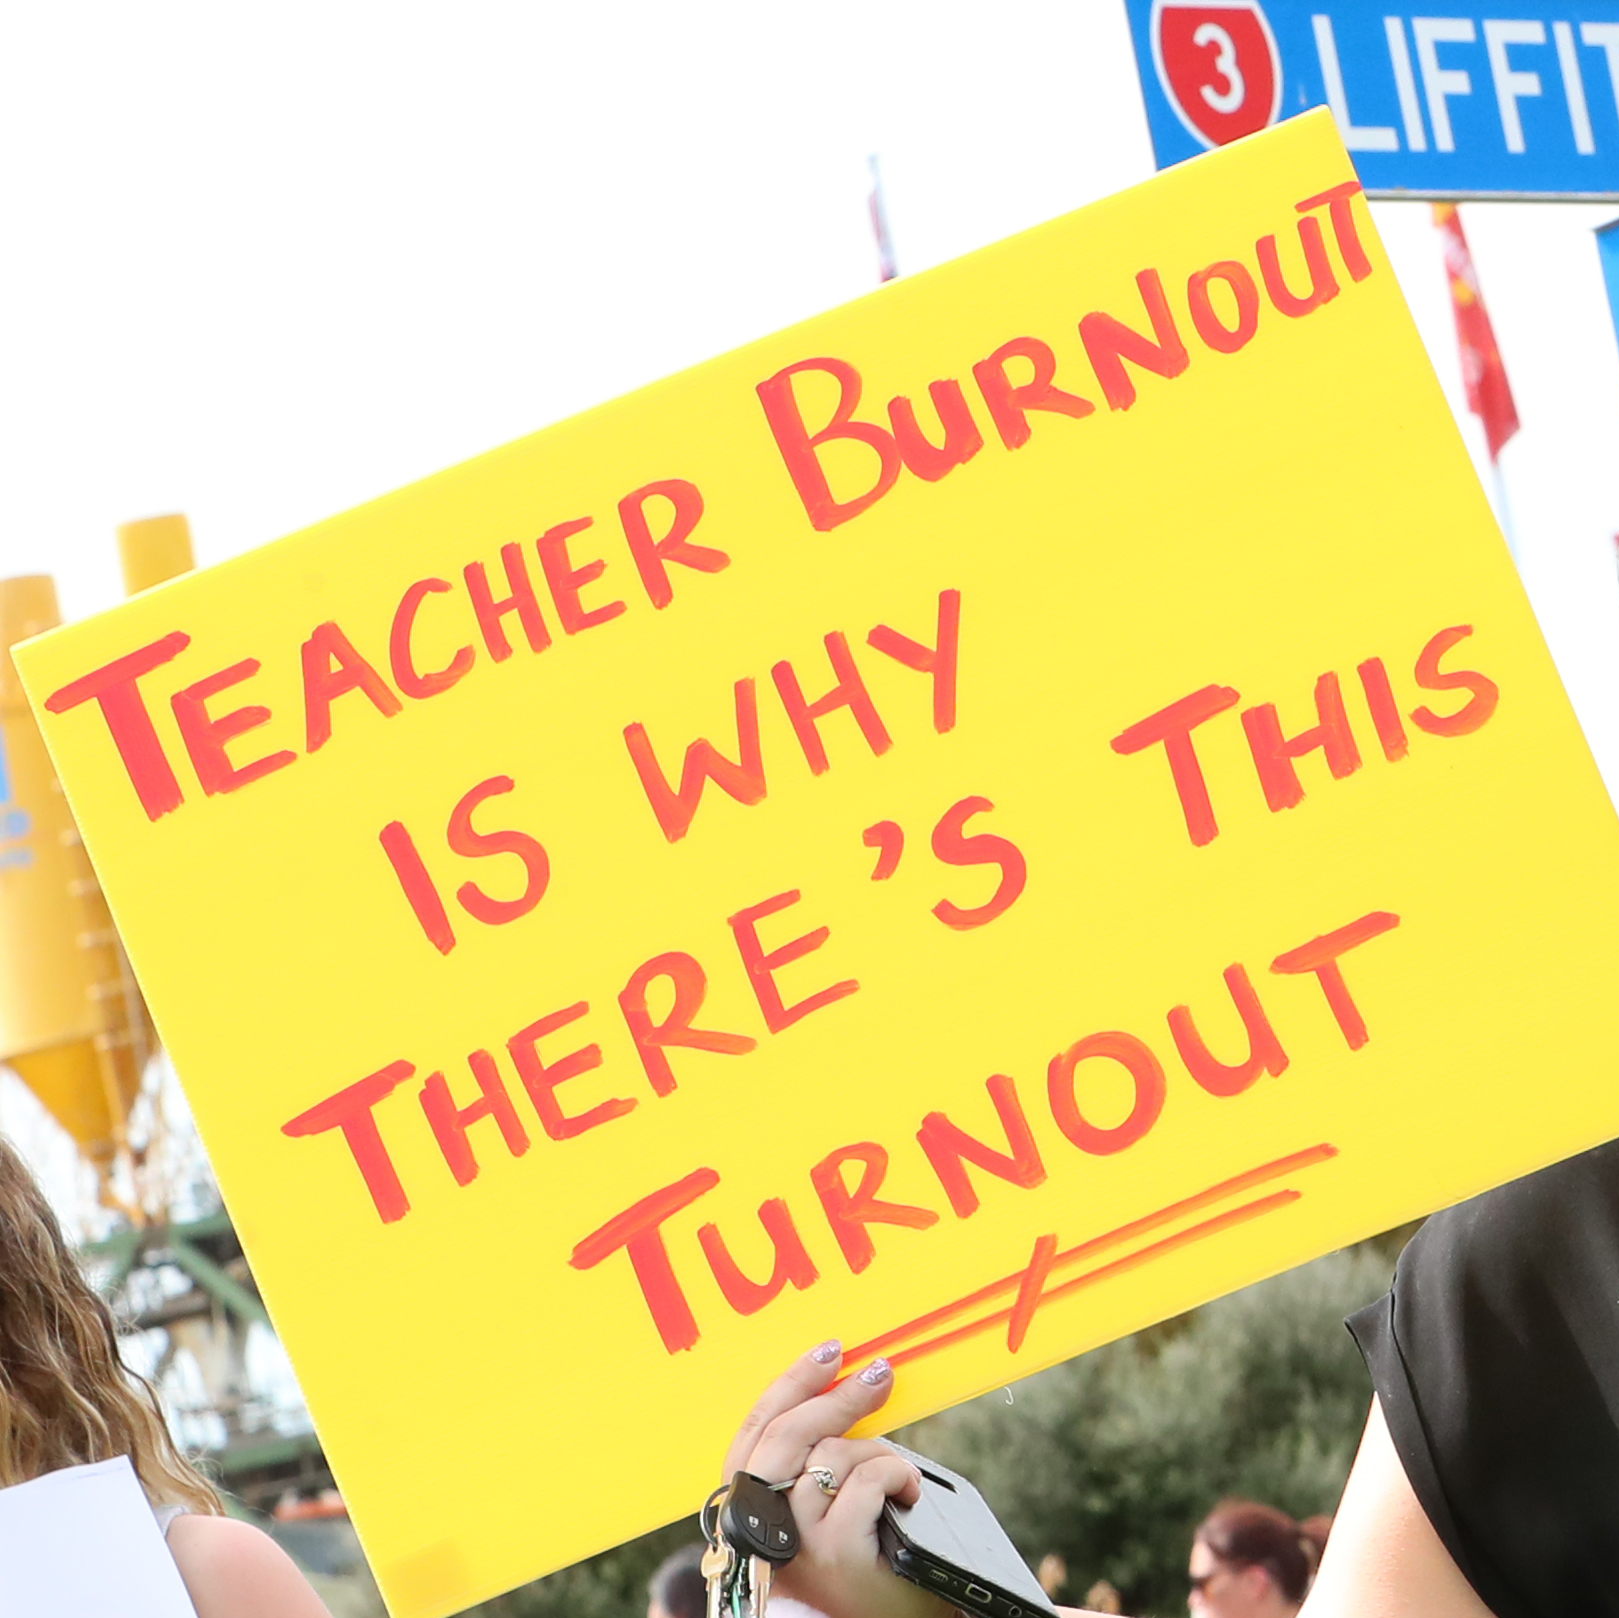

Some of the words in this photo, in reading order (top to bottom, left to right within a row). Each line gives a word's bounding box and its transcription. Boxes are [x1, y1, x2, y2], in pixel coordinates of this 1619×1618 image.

[1193, 22, 1246, 114] 3
[45, 479, 728, 821] TEACHER
[380, 775, 549, 954] IS
[624, 589, 960, 842] WHY
[282, 796, 1026, 1223] THERE'S
[1111, 625, 1498, 846] THIS
[571, 911, 1399, 1353] TURNOUT
